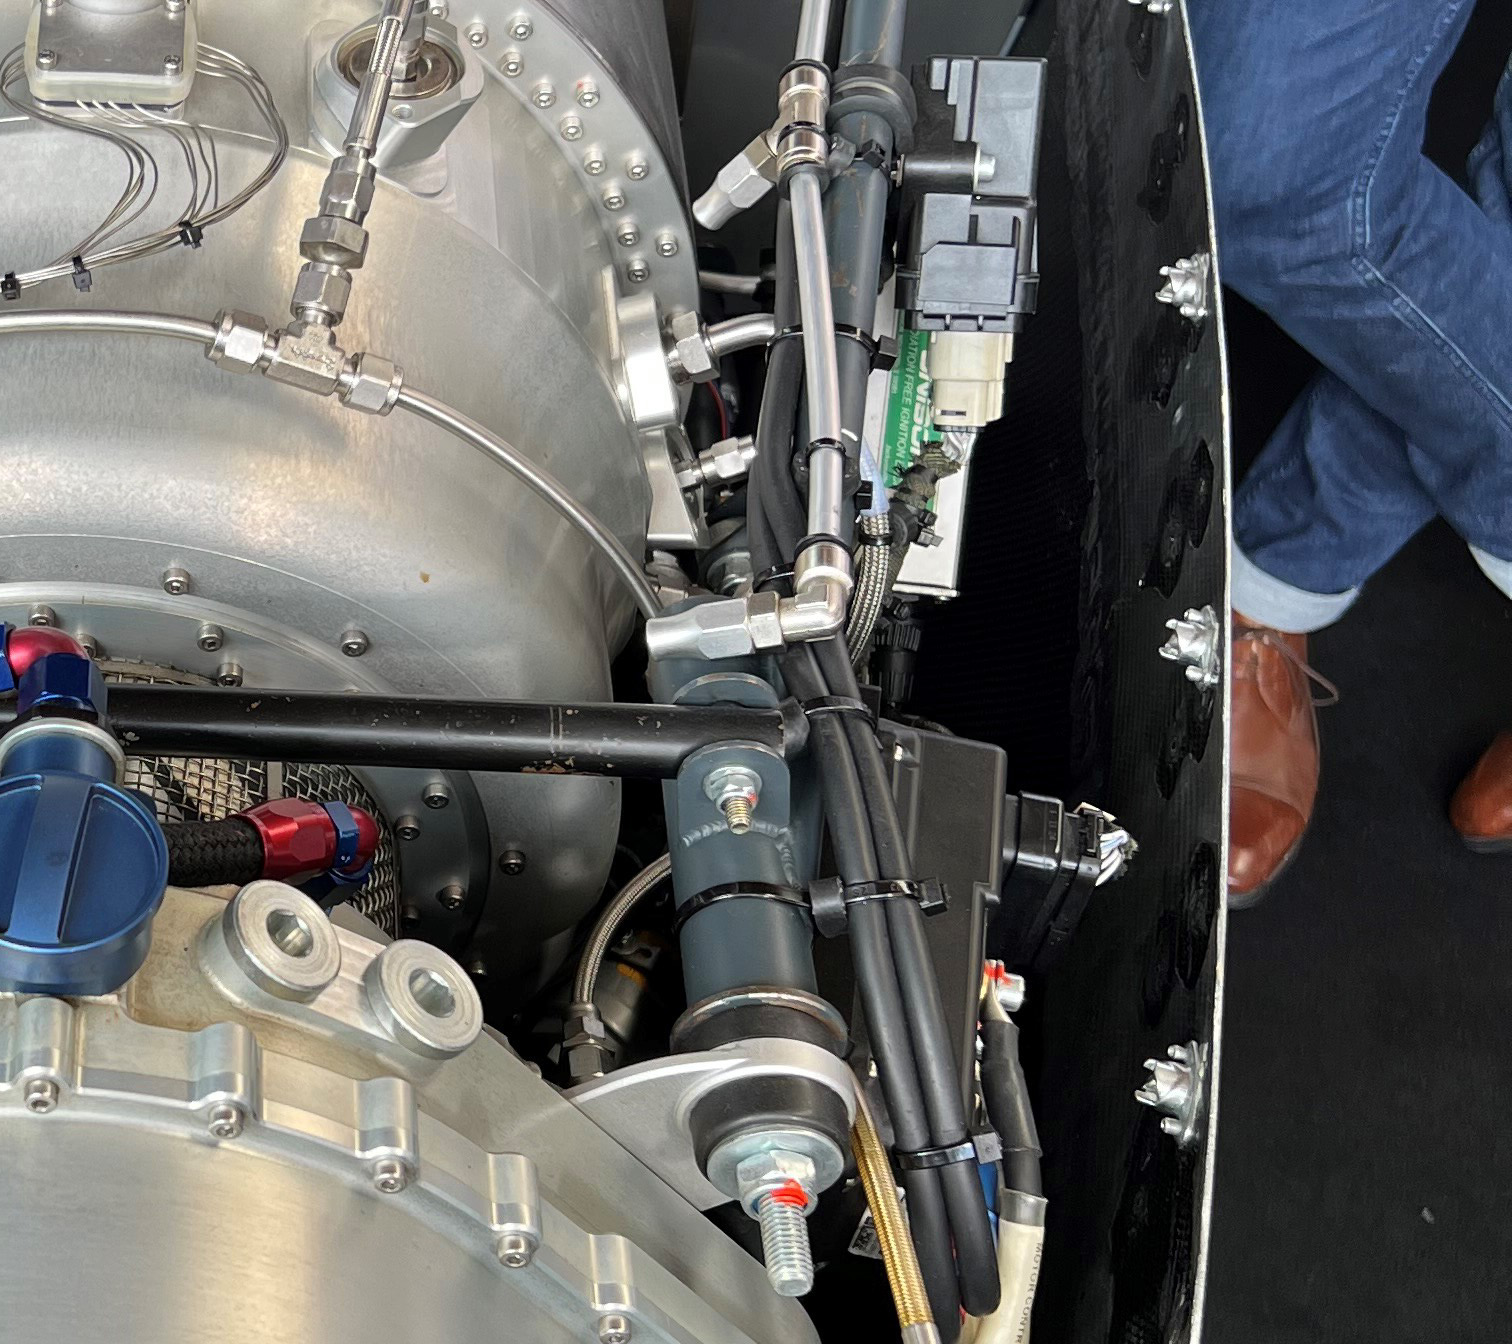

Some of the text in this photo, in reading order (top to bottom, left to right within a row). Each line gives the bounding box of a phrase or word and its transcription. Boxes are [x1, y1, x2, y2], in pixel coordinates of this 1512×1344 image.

[902, 374, 914, 405] FREE
[896, 407, 910, 458] IGNITION
[1027, 1243, 1043, 1292] MOTOR
